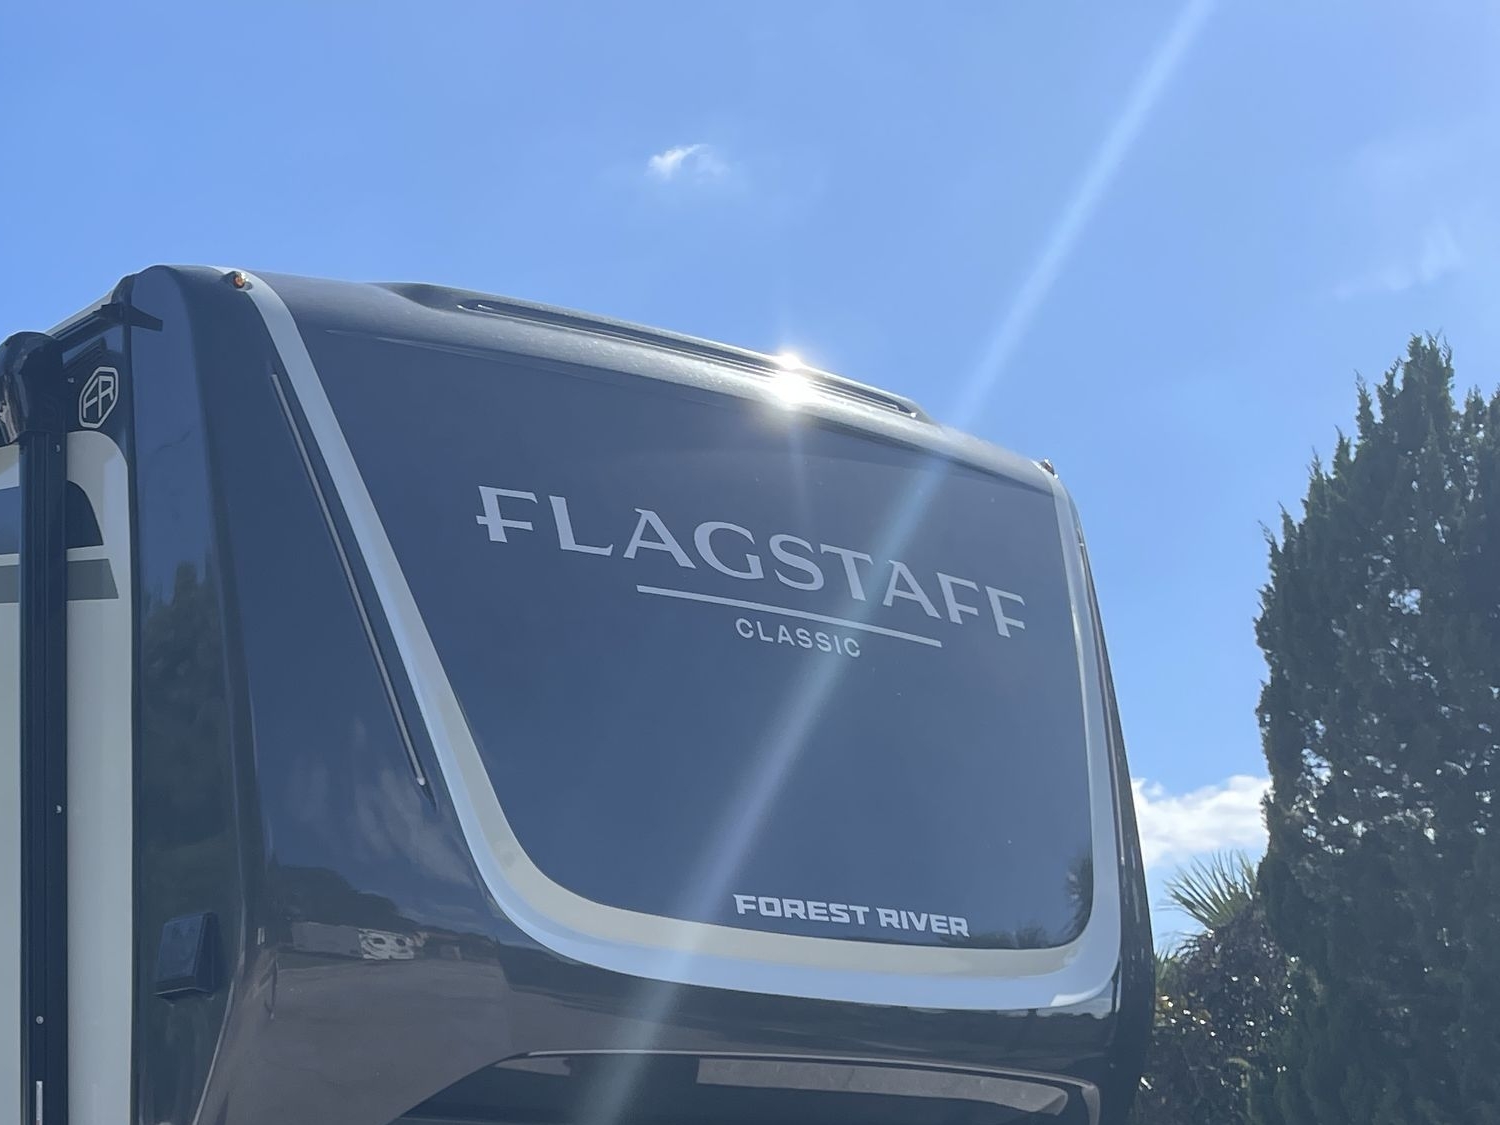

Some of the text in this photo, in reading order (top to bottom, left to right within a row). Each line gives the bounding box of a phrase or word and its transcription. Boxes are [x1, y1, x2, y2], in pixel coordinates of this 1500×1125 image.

[476, 485, 1027, 638] FLAGSTAFF
[735, 617, 861, 659] CLASSIC
[733, 894, 970, 938] FOREST RIVER
